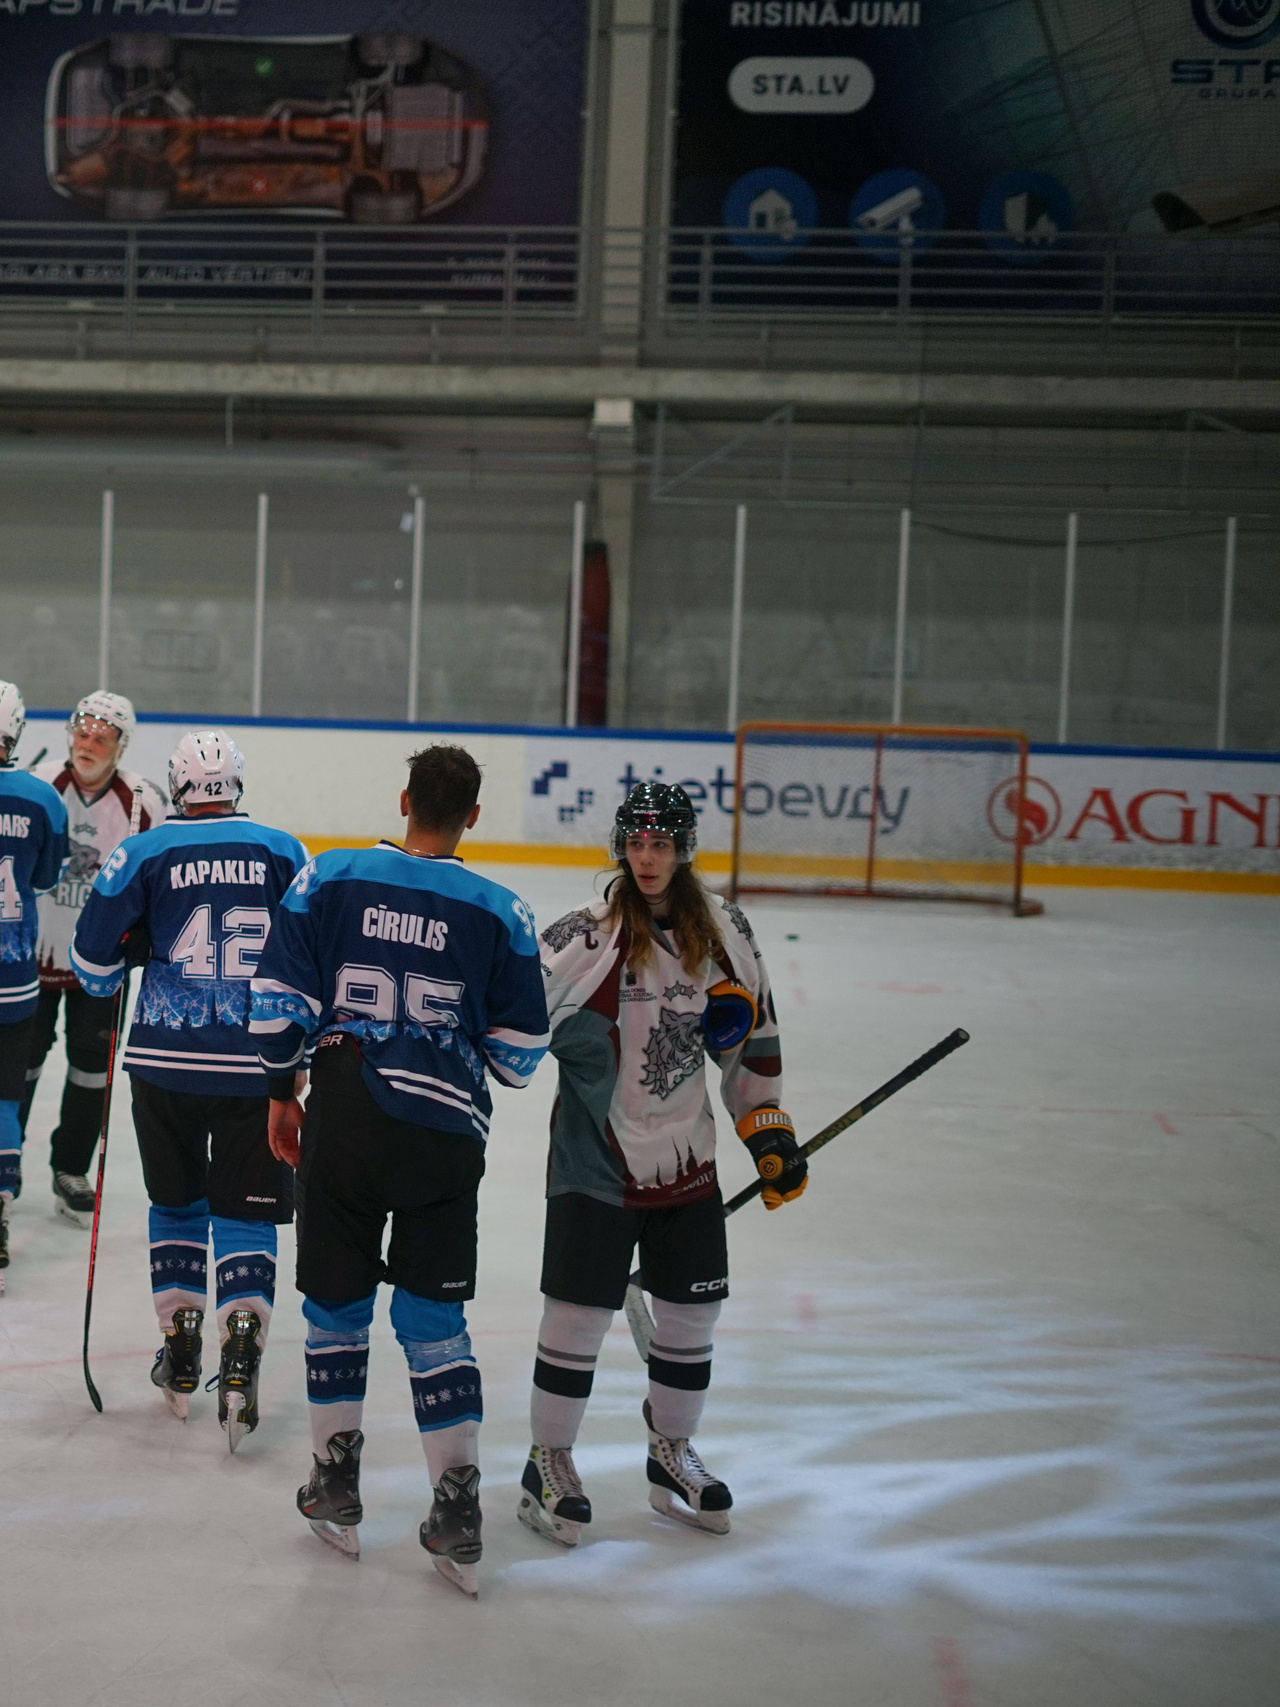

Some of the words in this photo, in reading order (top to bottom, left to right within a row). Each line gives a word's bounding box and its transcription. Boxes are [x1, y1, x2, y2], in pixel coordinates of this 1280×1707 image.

[753, 74, 850, 95] STA.LV
[204, 781, 222, 796] 42
[1062, 787, 1280, 848] AGN
[170, 859, 267, 889] KAPAKLIS
[55, 877, 93, 909] RĪG
[168, 903, 272, 980] 42
[361, 903, 449, 952] CĪRULIS
[332, 962, 466, 1030] 95
[246, 1195, 277, 1204] BAUER
[442, 1280, 468, 1289] BAUER
